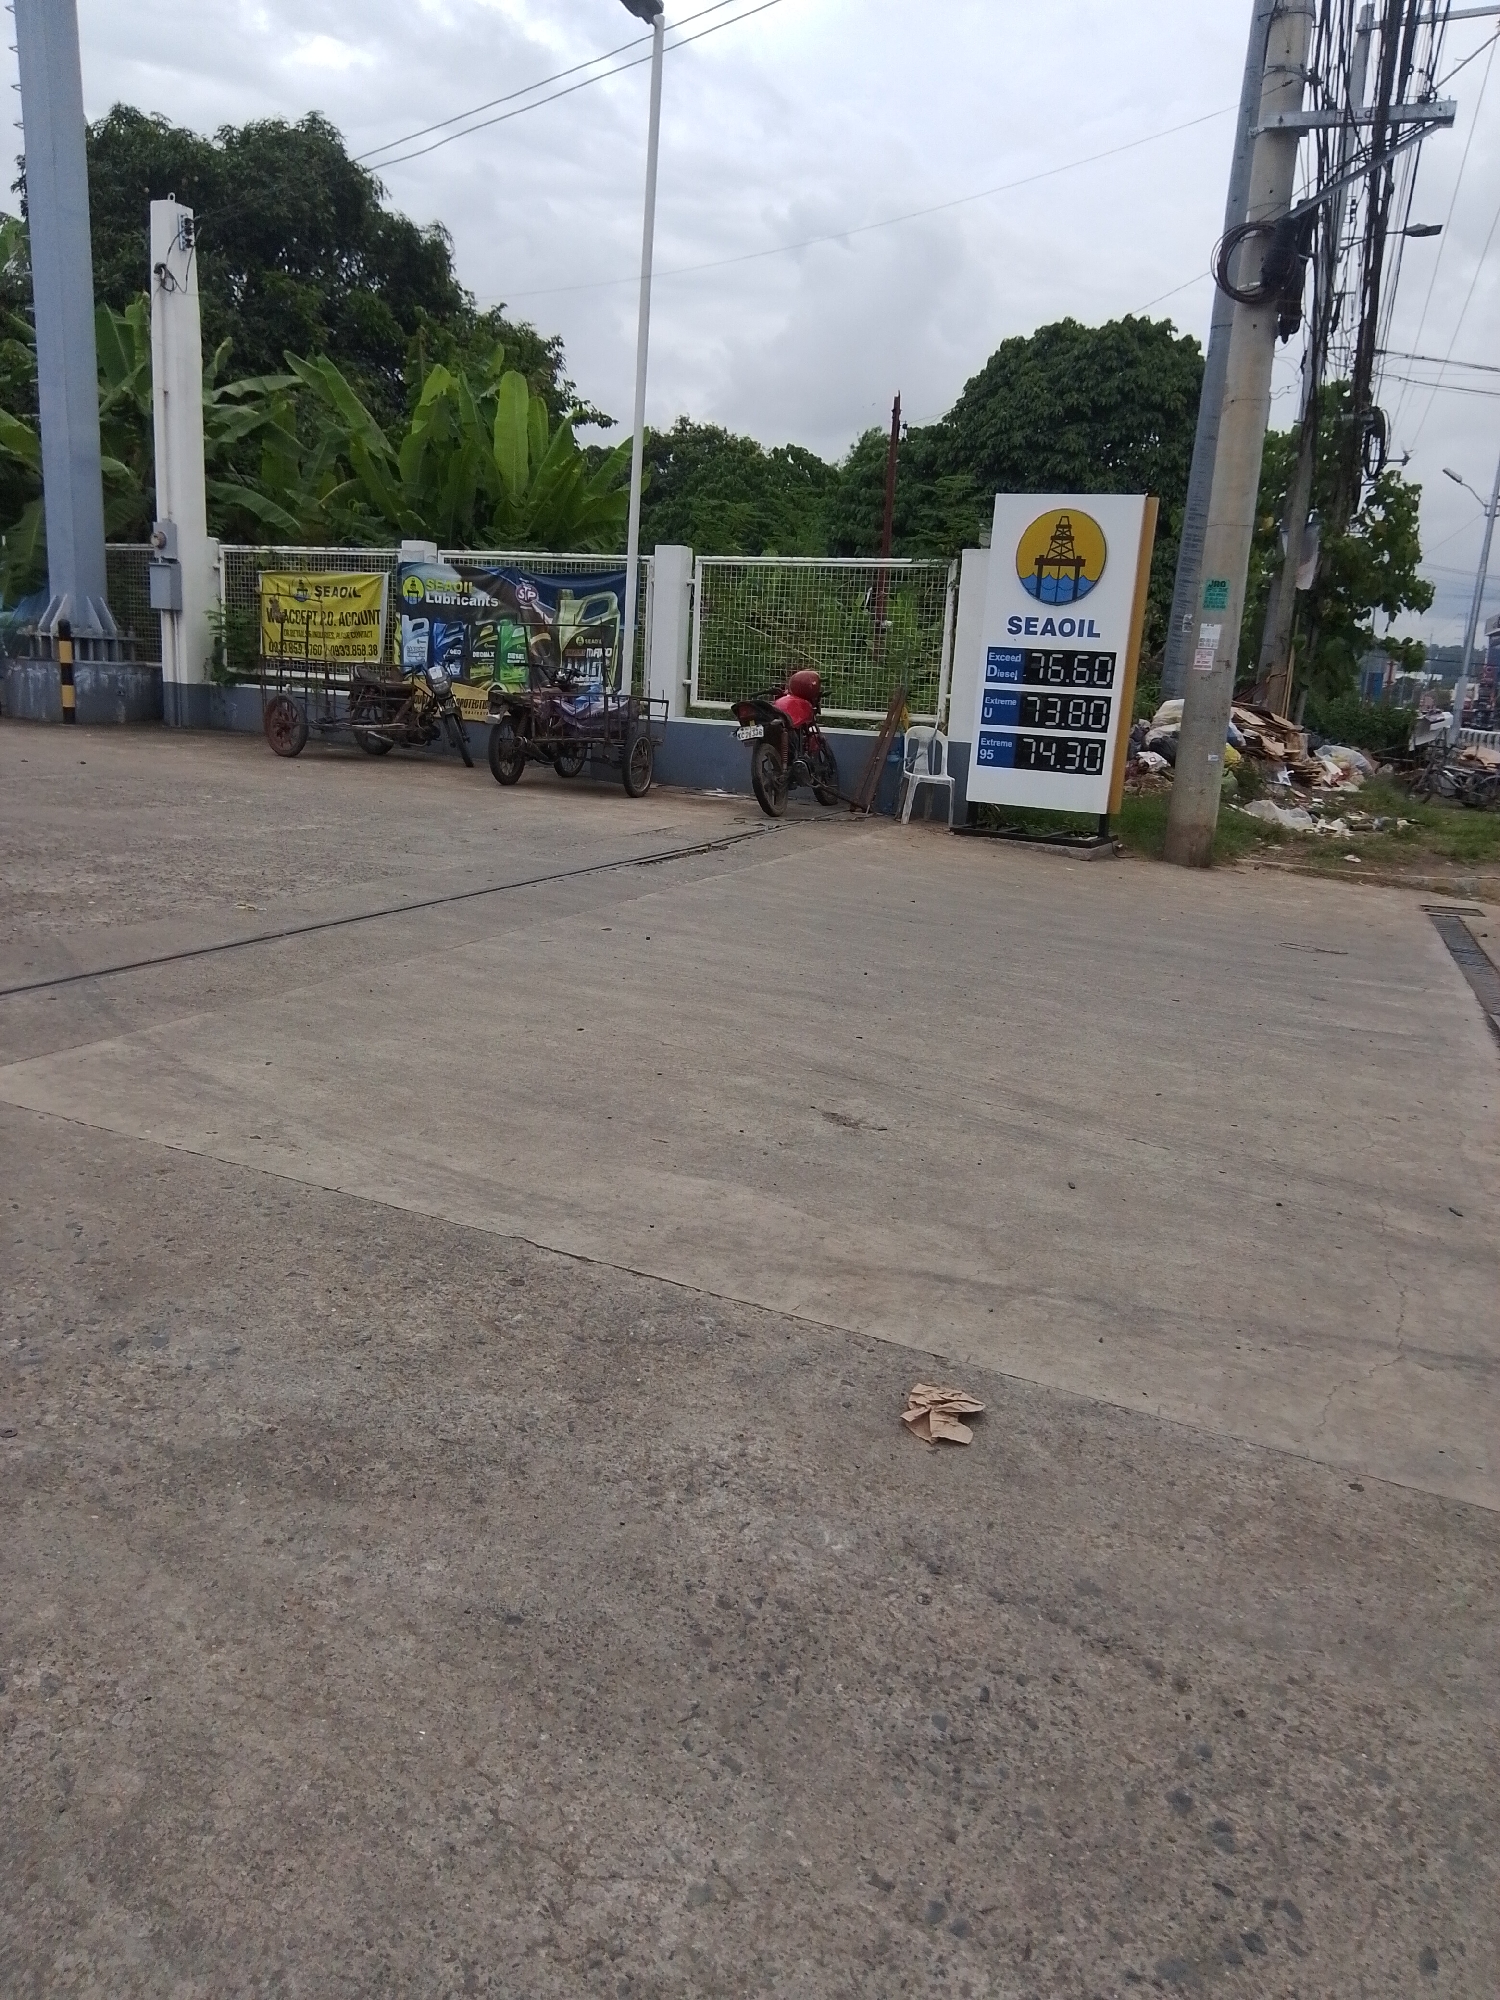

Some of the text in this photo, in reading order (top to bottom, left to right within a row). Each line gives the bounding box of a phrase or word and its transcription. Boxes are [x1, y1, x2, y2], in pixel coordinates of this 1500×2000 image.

[314, 585, 362, 598] SEAOIL
[425, 592, 499, 607] Lubricants
[518, 586, 536, 601] STP
[283, 608, 319, 626] ACCEPT
[339, 609, 381, 627] ACCOUNT
[1007, 616, 1101, 638] SEAOIL
[986, 665, 1018, 681] Diesel
[988, 652, 1112, 685] Exceed 76.60
[983, 708, 993, 719] U
[985, 696, 1108, 729] Extreme 73.80
[979, 749, 994, 760] 95
[980, 737, 1102, 772] Extreme 74.30
